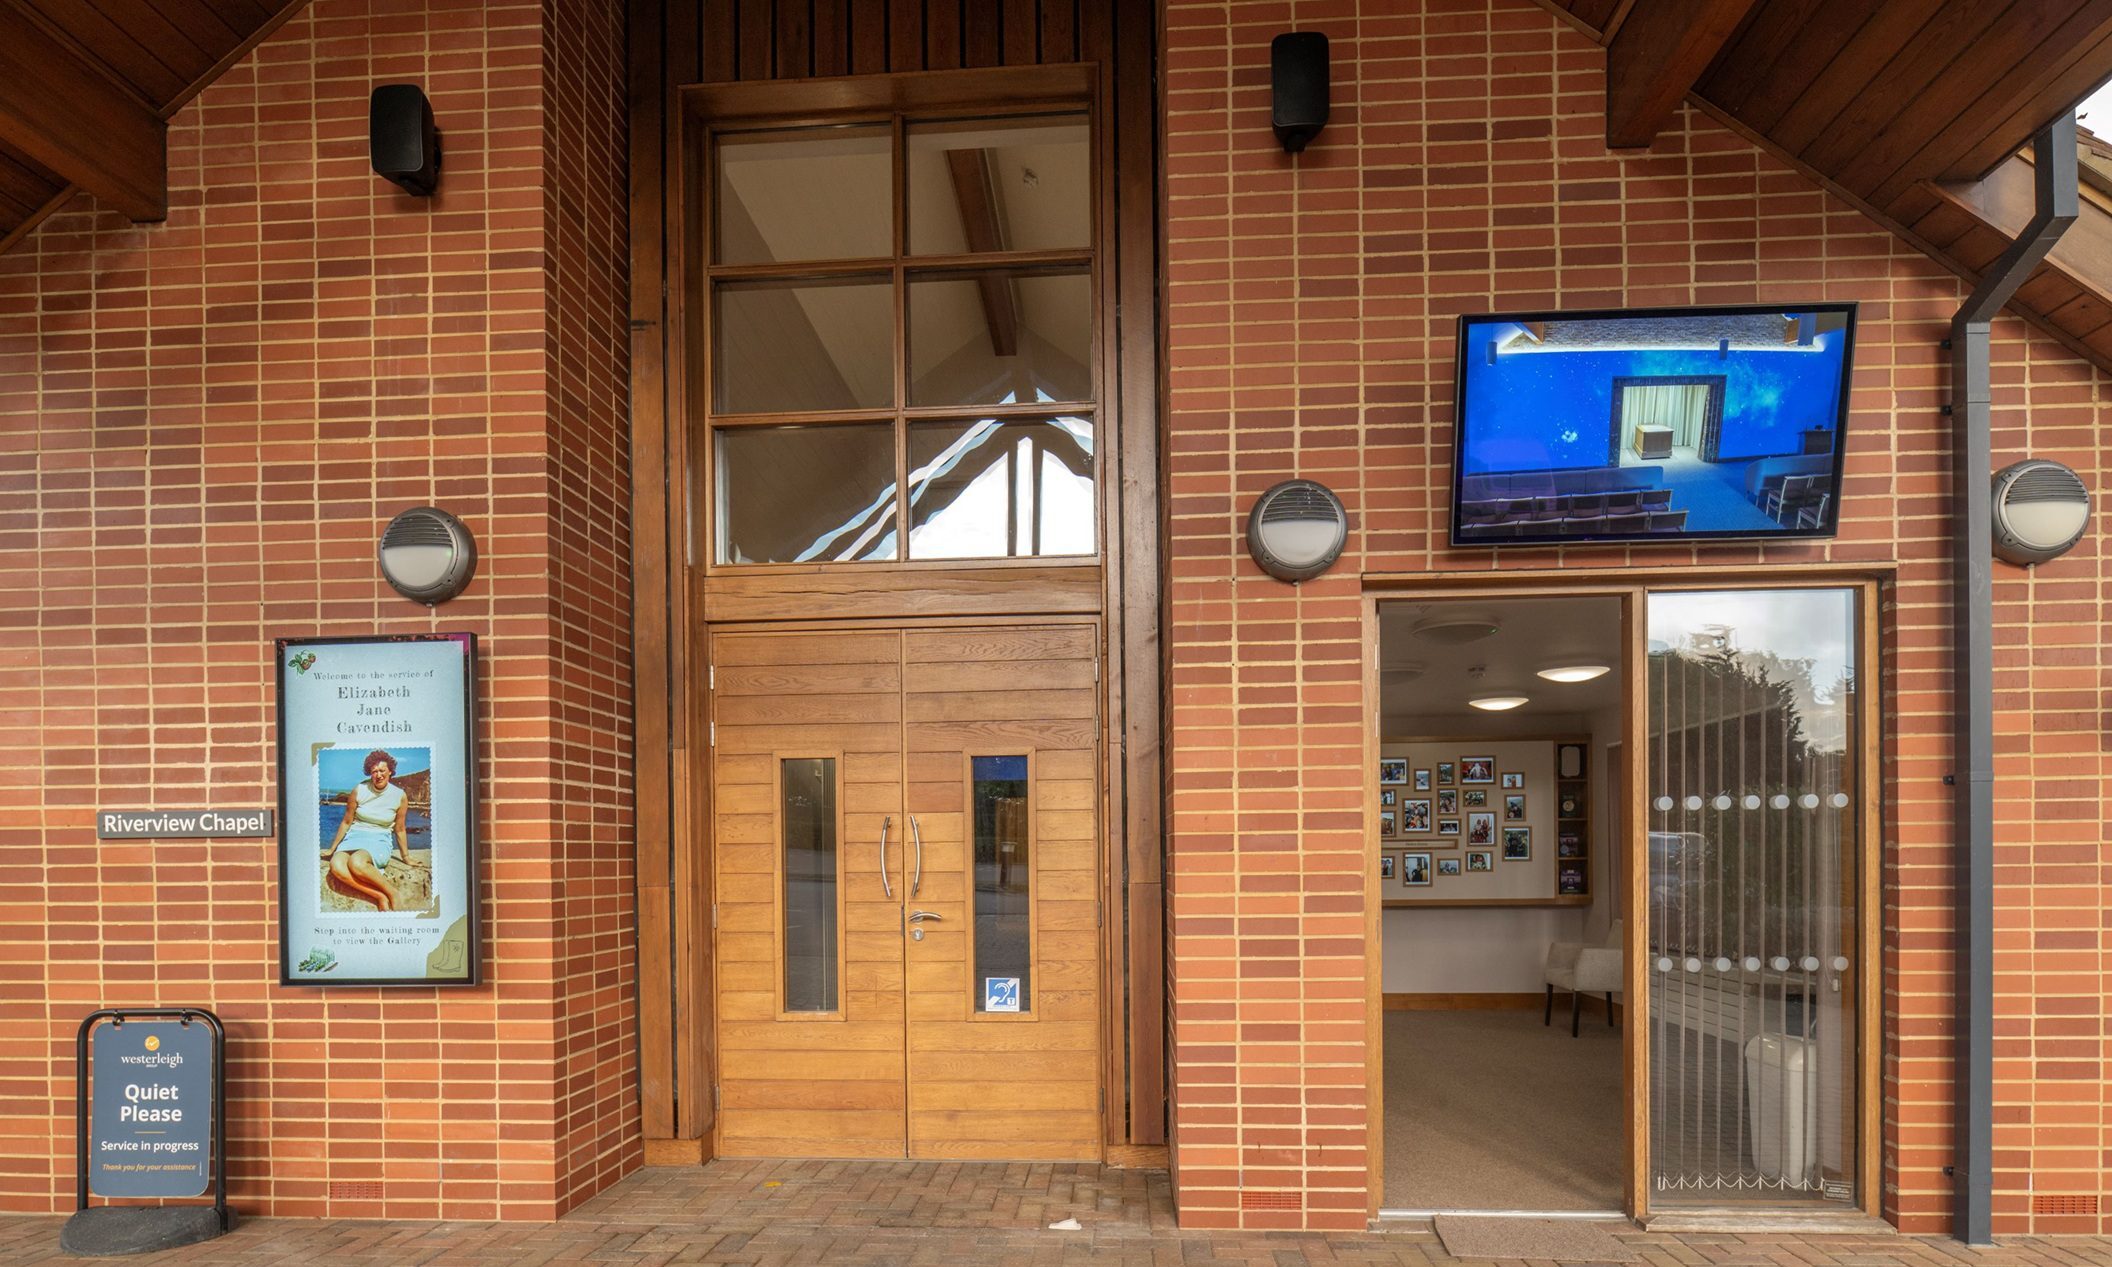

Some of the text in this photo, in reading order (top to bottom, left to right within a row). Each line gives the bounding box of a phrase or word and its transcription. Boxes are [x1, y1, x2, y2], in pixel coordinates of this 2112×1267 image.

[314, 672, 353, 680] Welcome
[370, 671, 385, 679] the
[389, 671, 420, 679] service
[424, 669, 434, 678] of
[337, 685, 411, 699] Elizabeth
[357, 704, 391, 716] Jane
[337, 720, 412, 734] Cavendish
[104, 812, 264, 834] Riverview Chapel
[314, 927, 335, 936] Step
[360, 926, 375, 934] the
[379, 927, 413, 936] waiting
[346, 937, 365, 945] view
[369, 937, 384, 945] the
[387, 937, 421, 946] Gallery
[121, 1052, 183, 1069] westerleigh
[125, 1083, 179, 1104] Quiet
[120, 1105, 183, 1122] Please
[101, 1140, 199, 1153] Service in progress
[135, 1164, 146, 1172] for
